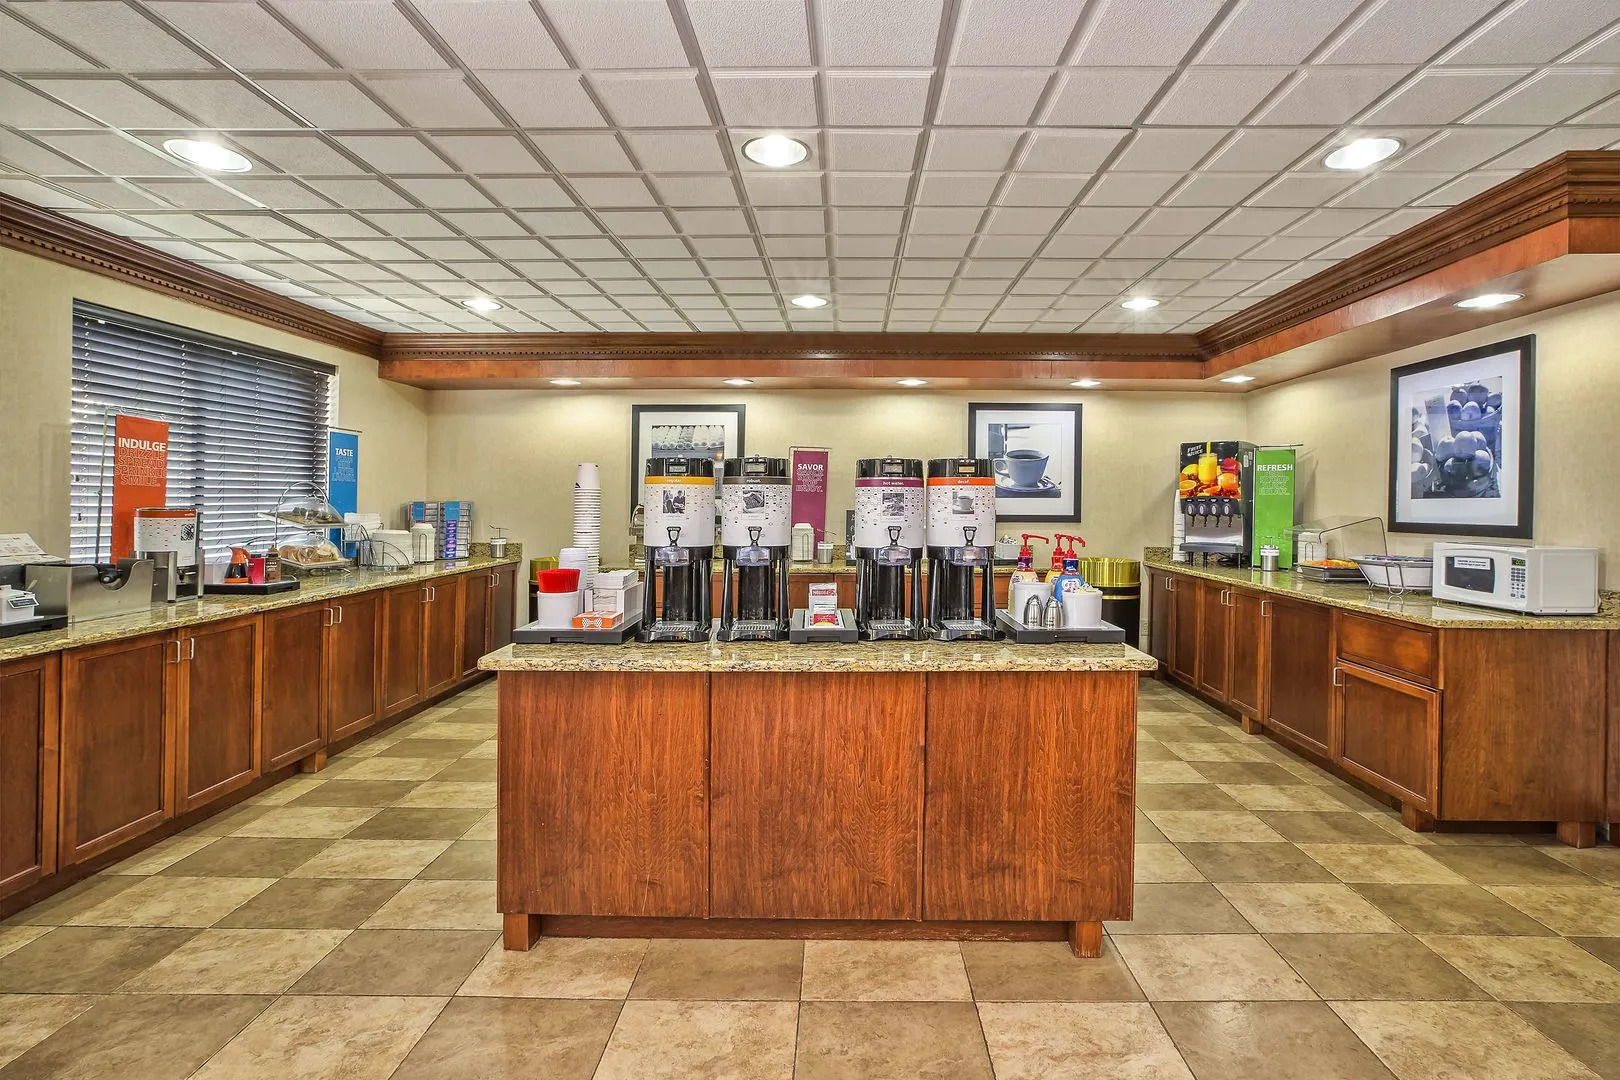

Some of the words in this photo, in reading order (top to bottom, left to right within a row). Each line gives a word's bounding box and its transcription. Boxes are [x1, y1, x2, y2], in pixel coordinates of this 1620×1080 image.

[118, 437, 167, 452] INDULGE
[335, 447, 354, 457] TASTE
[797, 463, 824, 471] SAVOR
[1257, 464, 1293, 472] REFRESH
